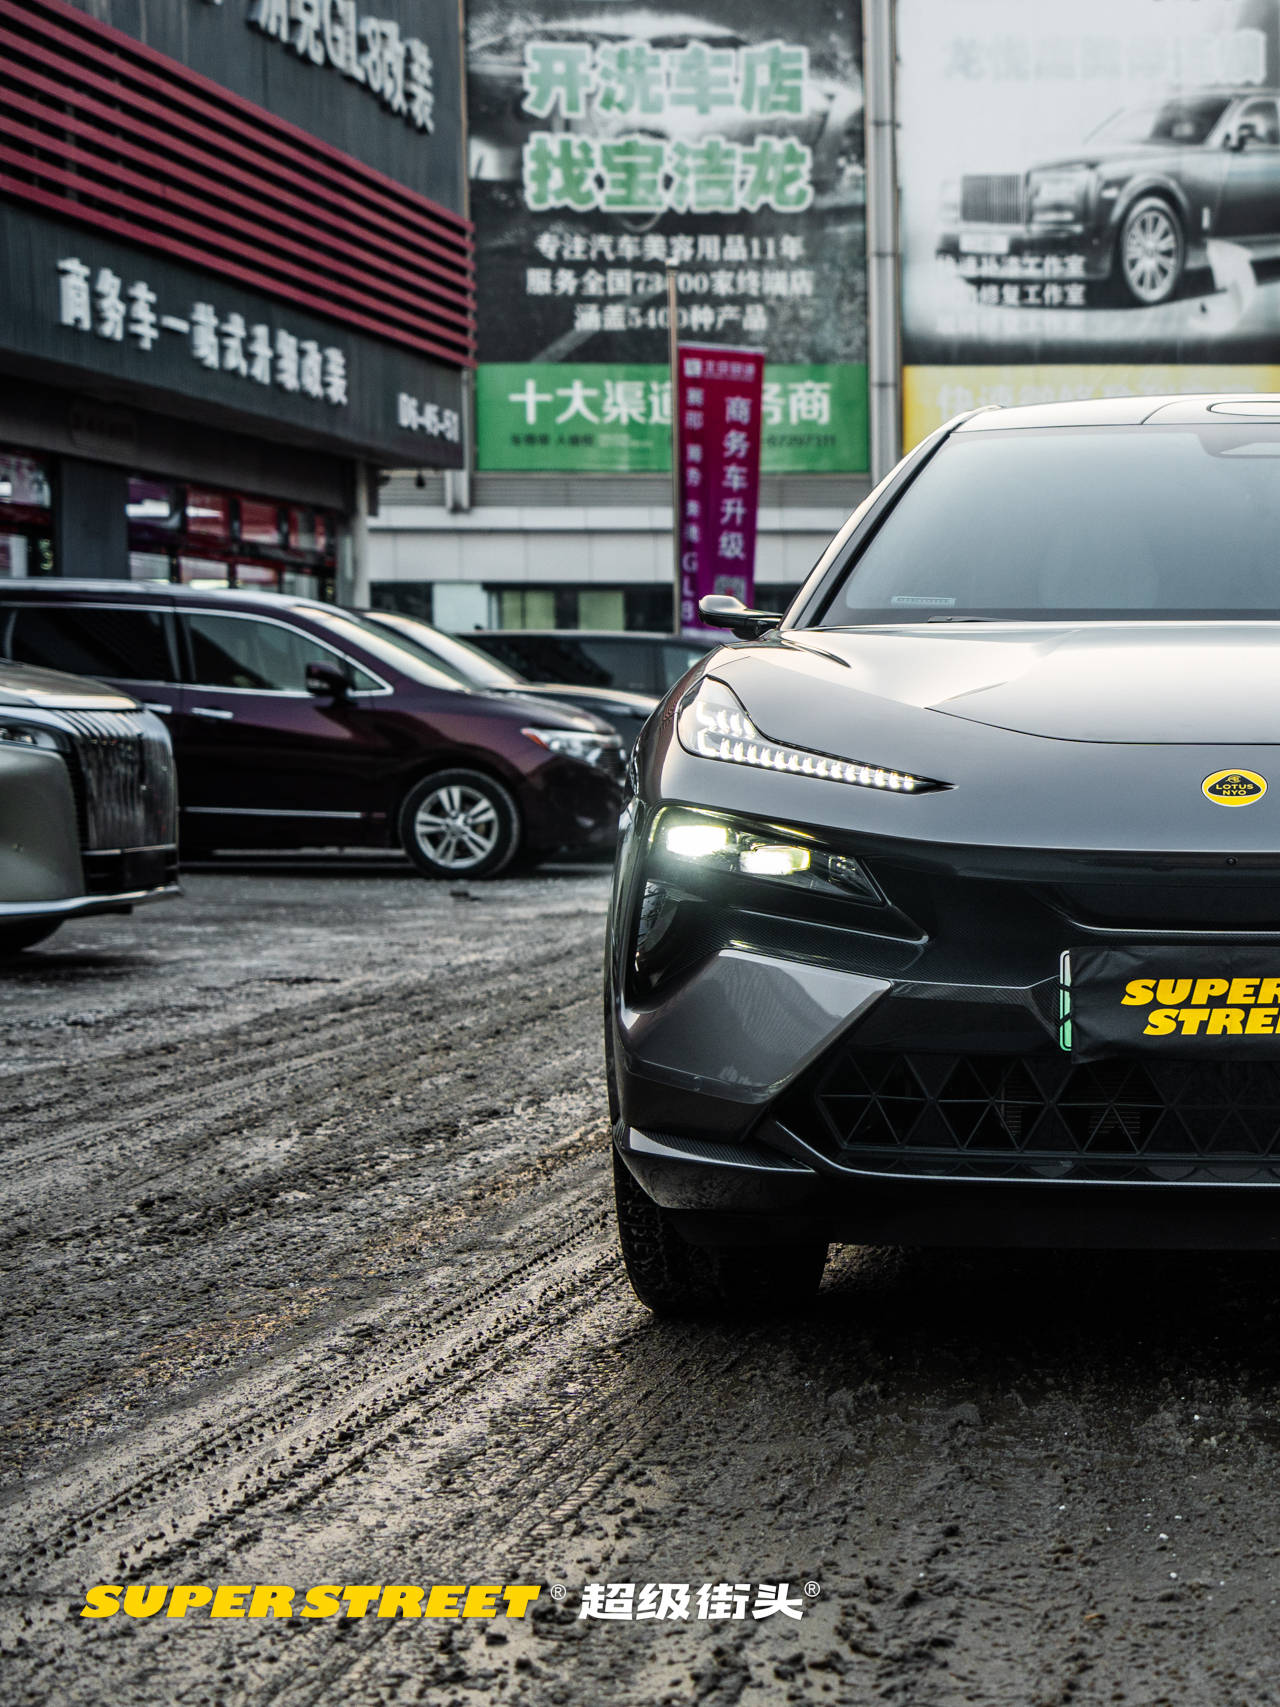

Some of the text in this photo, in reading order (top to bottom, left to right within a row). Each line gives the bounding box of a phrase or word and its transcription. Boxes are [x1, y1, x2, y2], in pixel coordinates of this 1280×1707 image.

[522, 41, 810, 118] 开洗车店
[522, 131, 815, 213] 找宝洁龙
[525, 267, 815, 297] 服务全国7300家终端店
[722, 395, 753, 561] 商务车升级
